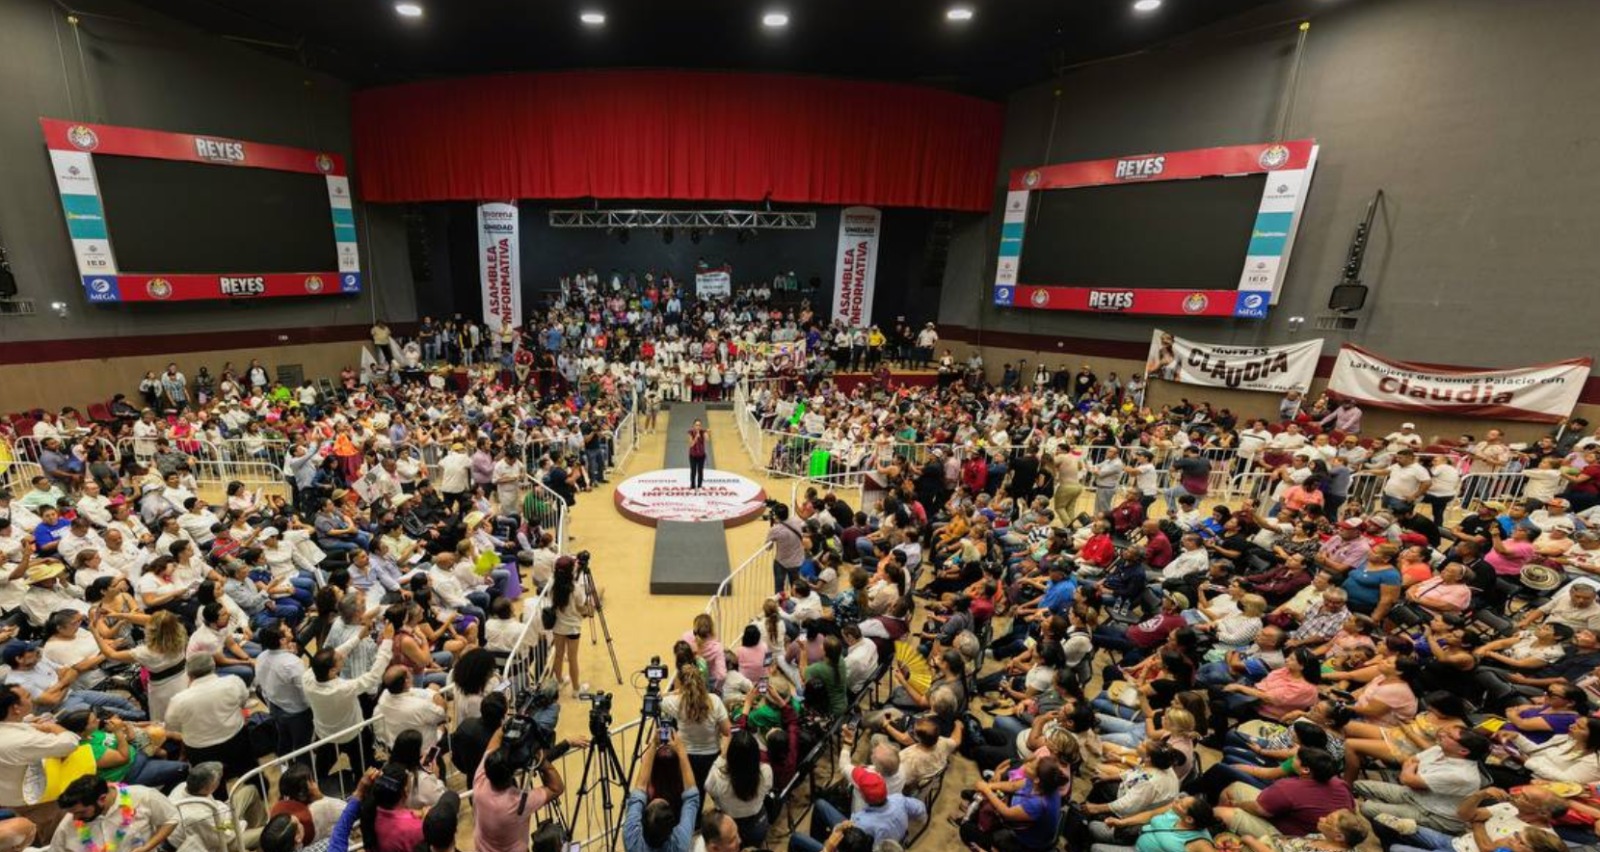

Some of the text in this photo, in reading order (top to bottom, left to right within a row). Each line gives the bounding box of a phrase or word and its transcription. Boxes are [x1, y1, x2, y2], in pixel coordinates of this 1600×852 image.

[195, 138, 244, 160] REYES
[1115, 156, 1165, 177] REYES
[220, 276, 265, 294] REYES
[487, 245, 499, 315] ASAMBLEA
[499, 238, 512, 323] INFORMATIVA
[839, 249, 856, 317] ASAMBLEA
[852, 241, 867, 324] INFORMATIVA
[1089, 290, 1134, 308] REYES
[1238, 308, 1263, 316] MEGA
[1187, 348, 1288, 387] CLAUDIA
[1350, 361, 1368, 369] Las
[1369, 365, 1413, 379] Mujeres
[1484, 377, 1536, 385] Palacio
[1378, 376, 1514, 404] Claudia
